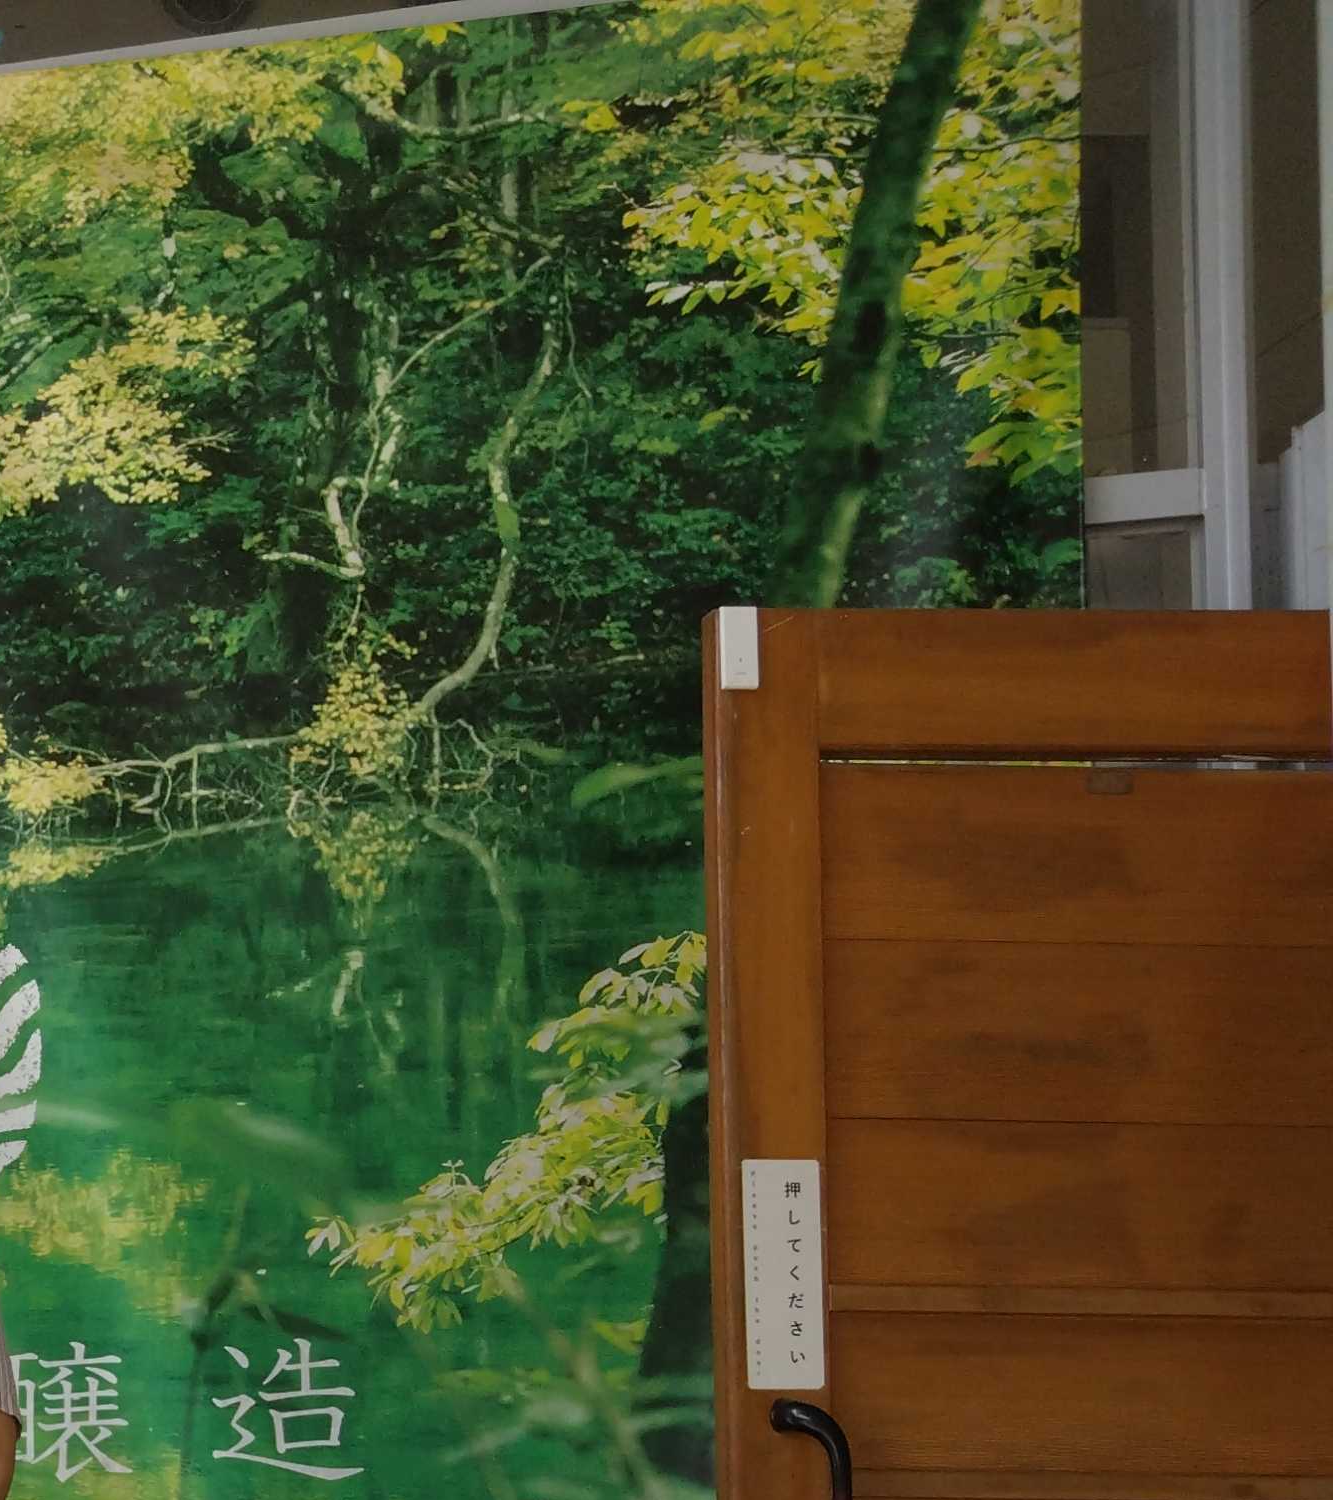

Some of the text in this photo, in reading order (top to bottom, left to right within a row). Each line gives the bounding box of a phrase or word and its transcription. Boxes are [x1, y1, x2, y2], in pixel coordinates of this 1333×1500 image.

[784, 1181, 806, 1364] 押してください
